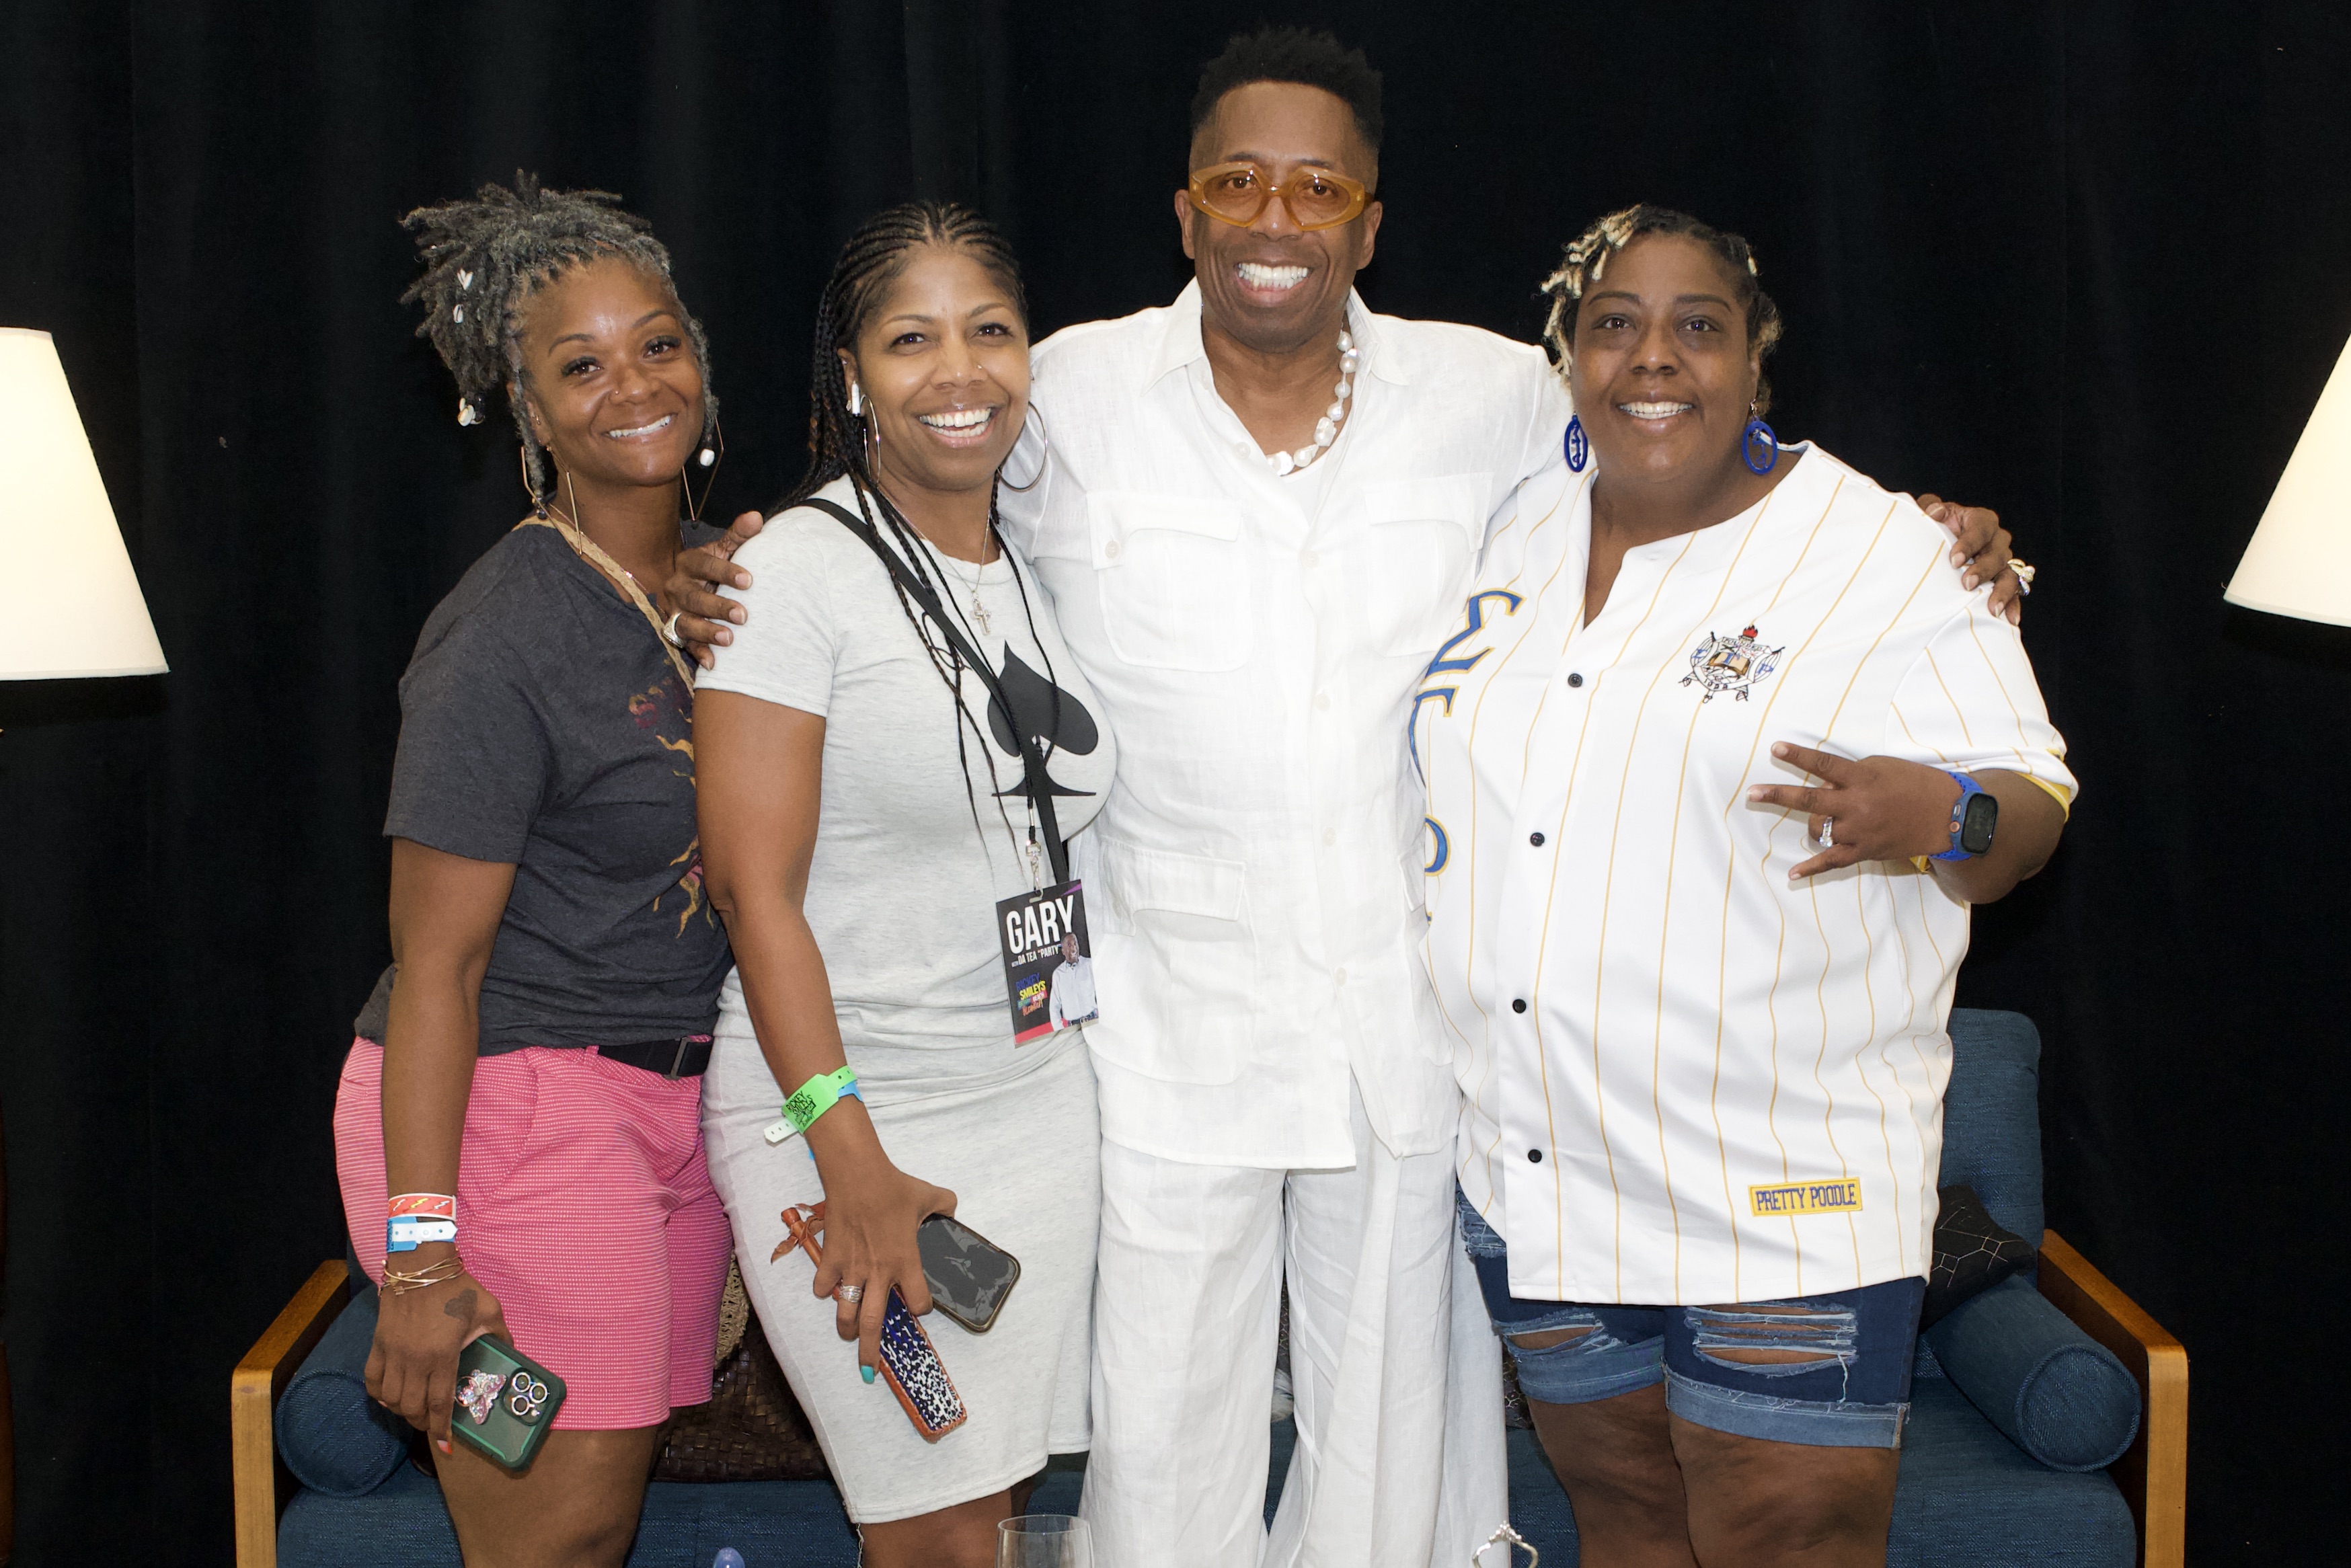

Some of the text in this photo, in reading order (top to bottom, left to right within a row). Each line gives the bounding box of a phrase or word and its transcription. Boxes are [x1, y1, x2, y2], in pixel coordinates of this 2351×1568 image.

[1006, 895, 1074, 954] GARY
[1017, 954, 1026, 965] DA
[1026, 951, 1038, 962] TEA
[1015, 972, 1040, 992] RICKEY
[786, 1091, 806, 1113] RICKEY
[1755, 1183, 1857, 1211] PRETTY POODLE
